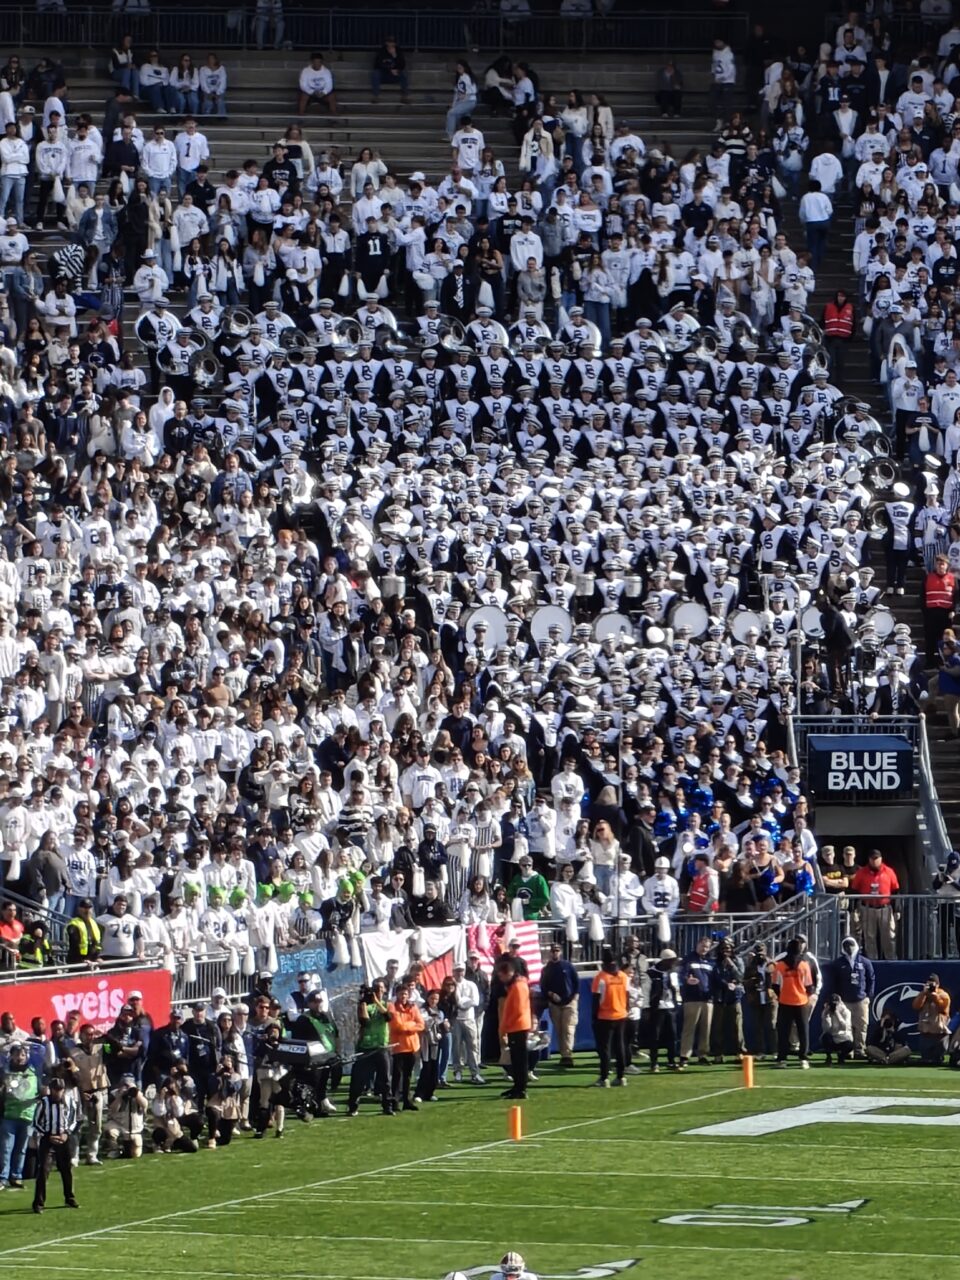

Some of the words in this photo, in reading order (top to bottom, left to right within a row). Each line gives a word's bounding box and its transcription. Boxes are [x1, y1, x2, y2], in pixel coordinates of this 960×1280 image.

[185, 142, 190, 157] 1
[941, 160, 946, 173] 1
[368, 238, 381, 255] 11
[831, 751, 897, 770] BLUE
[828, 771, 901, 790] BAND
[51, 980, 125, 1020] weis
